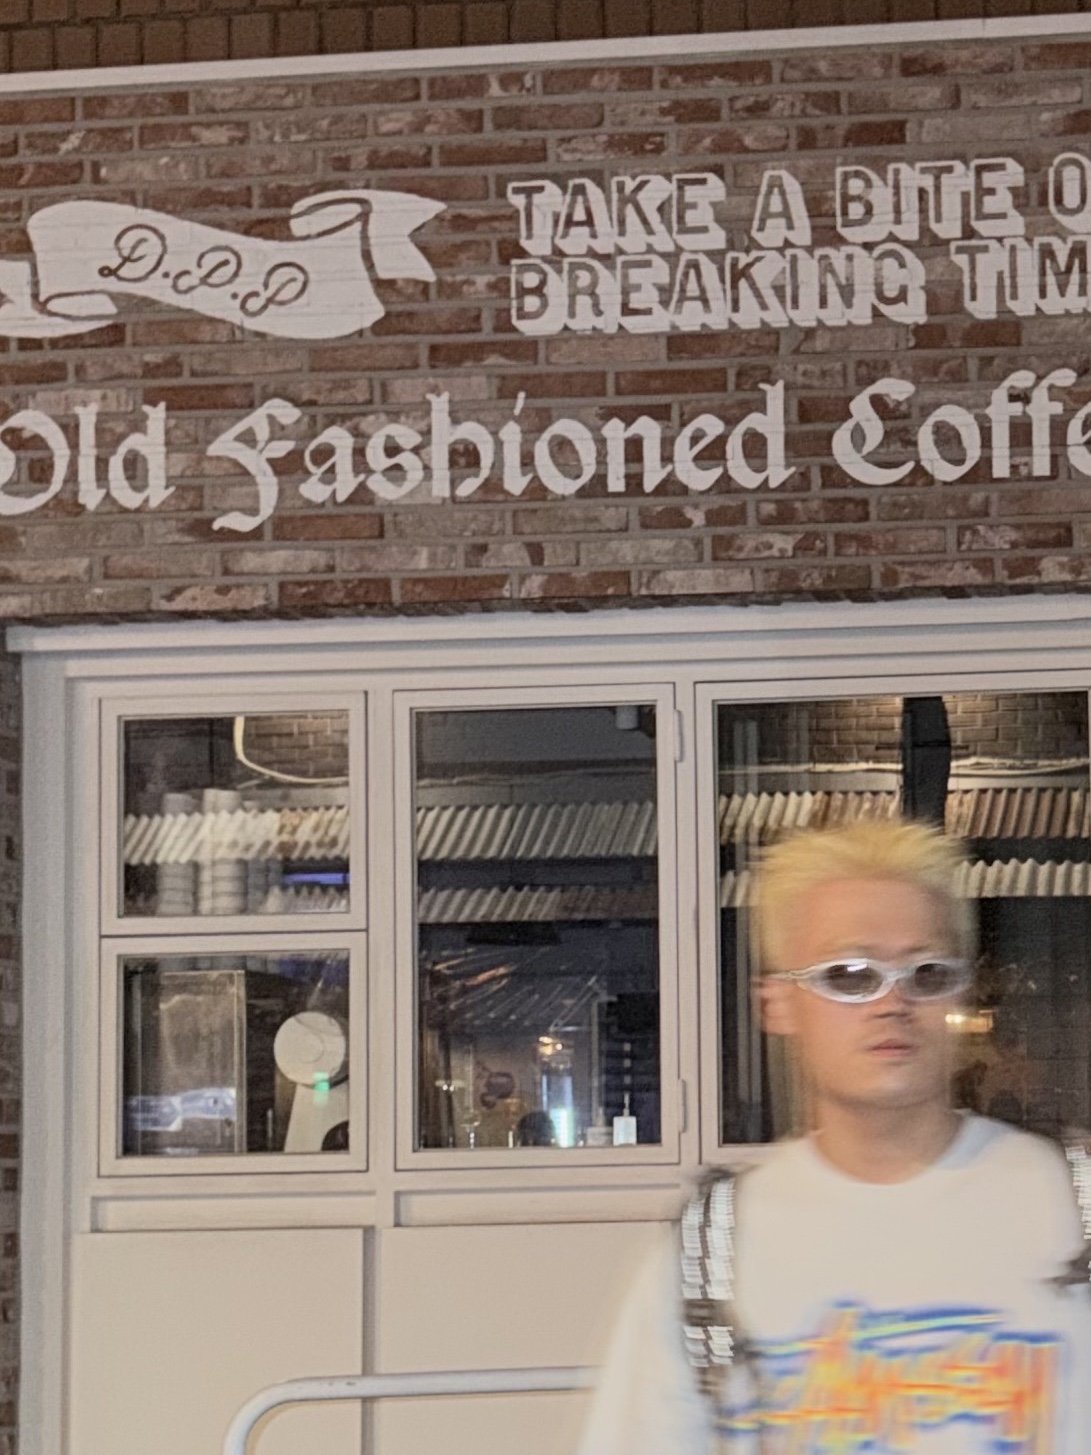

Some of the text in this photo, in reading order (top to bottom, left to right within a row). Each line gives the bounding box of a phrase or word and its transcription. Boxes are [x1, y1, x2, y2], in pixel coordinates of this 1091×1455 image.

[507, 171, 726, 256] TAKE
[750, 169, 812, 248] A
[836, 156, 1025, 244] BITE
[511, 242, 928, 336] BREAKING
[0, 401, 176, 516] Old
[206, 380, 796, 532] Fashioned
